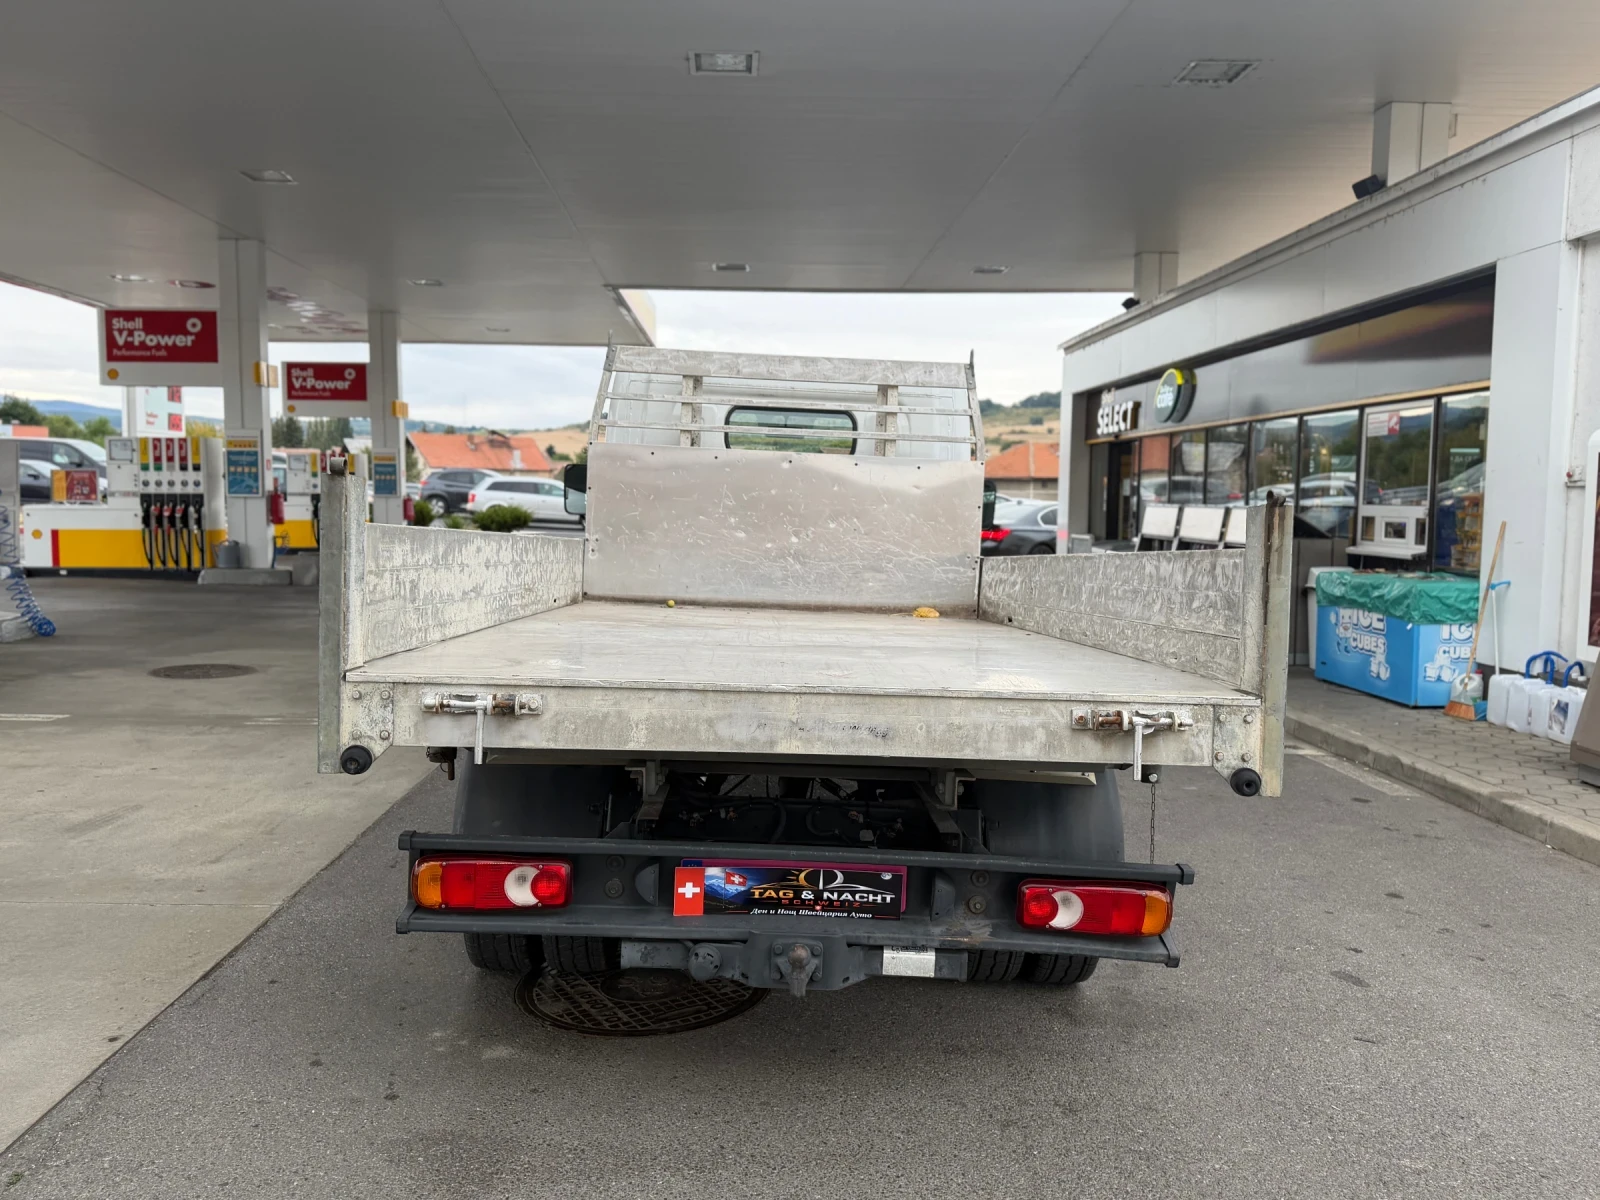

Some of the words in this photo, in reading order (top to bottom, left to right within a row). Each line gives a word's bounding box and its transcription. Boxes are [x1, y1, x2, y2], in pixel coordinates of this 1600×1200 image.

[112, 317, 143, 330] Shell
[113, 330, 195, 347] V-Power
[291, 368, 314, 377] Shell
[292, 377, 351, 390] V-Power
[1096, 400, 1136, 436] SELECT
[1351, 608, 1386, 632] ICE
[1350, 632, 1386, 654] CUBES
[750, 889, 794, 899] TAG
[801, 890, 815, 900] &
[823, 891, 896, 904] NACHT
[781, 899, 861, 908] SCHWEIZ
